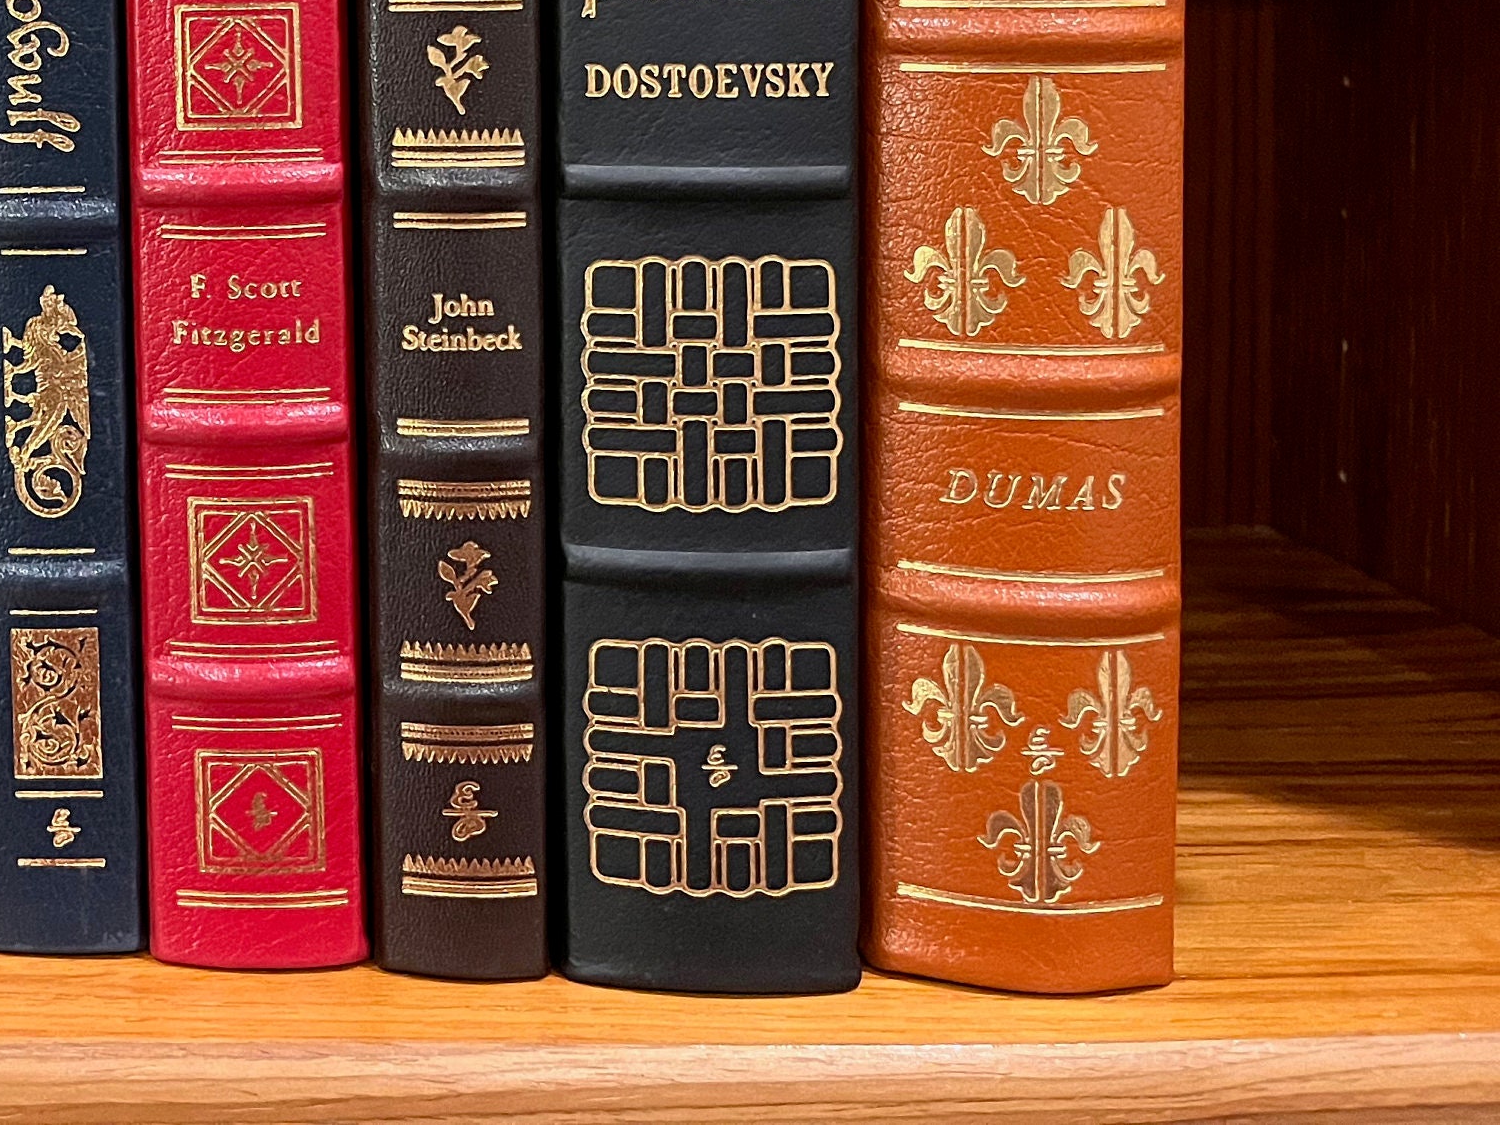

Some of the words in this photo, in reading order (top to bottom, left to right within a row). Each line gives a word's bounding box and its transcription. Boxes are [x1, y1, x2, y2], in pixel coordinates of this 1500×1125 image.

[584, 62, 835, 99] DOSTOEVSKY
[227, 274, 302, 300] Scott
[427, 293, 495, 324] John
[169, 318, 320, 353] Fitzgerald
[401, 324, 523, 353] Steinbeck
[938, 469, 1126, 511] DUMAS
